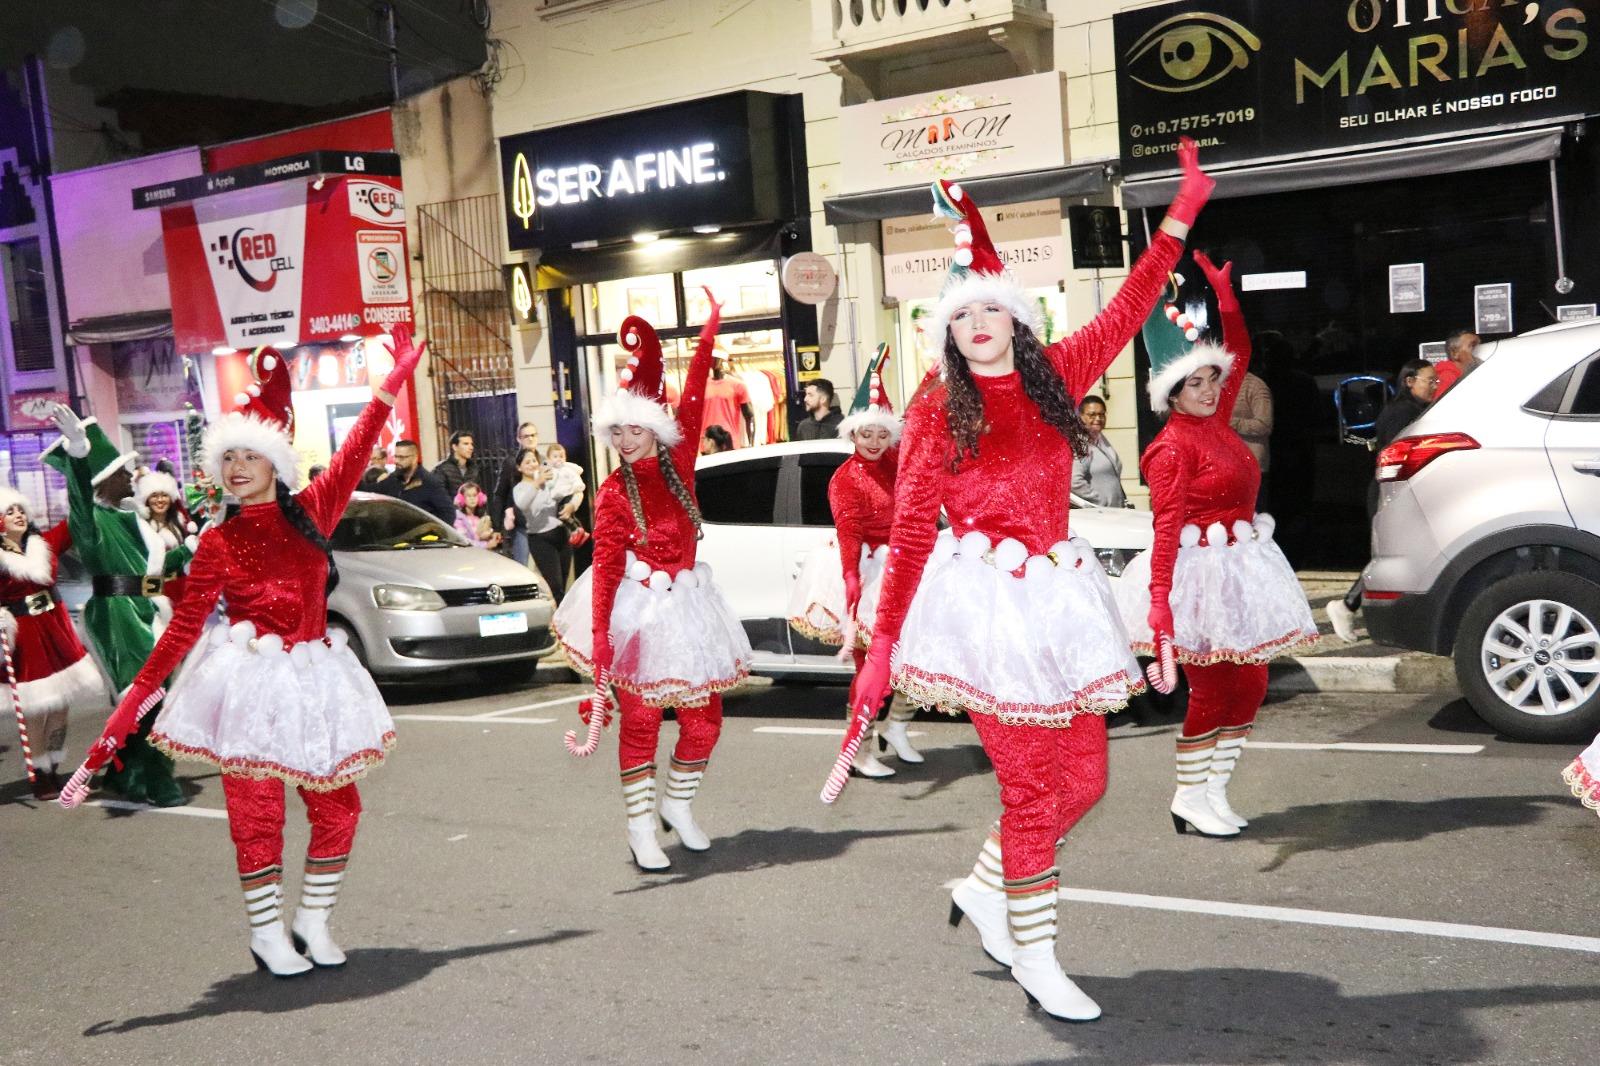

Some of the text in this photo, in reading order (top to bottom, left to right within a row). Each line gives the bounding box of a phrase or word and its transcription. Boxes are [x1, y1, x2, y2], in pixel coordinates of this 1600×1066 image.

[1294, 2, 1589, 104] MARIA'S
[1340, 86, 1556, 128] SEU OLHAR É NOSSO FOCO
[1144, 107, 1255, 136] 11 9.7575-7019
[946, 139, 998, 152] FEMININOS
[264, 160, 311, 177] MOTOROLA
[344, 156, 365, 171] LG
[215, 176, 235, 188] Apple
[144, 187, 176, 201] SAMSUNG
[373, 192, 396, 205] RED
[240, 233, 277, 261] RED
[270, 256, 295, 272] CELL
[270, 309, 295, 320] TÉCNICA
[363, 306, 412, 324] CONSERTE
[242, 328, 246, 336] E
[309, 313, 353, 335] 3403-4414
